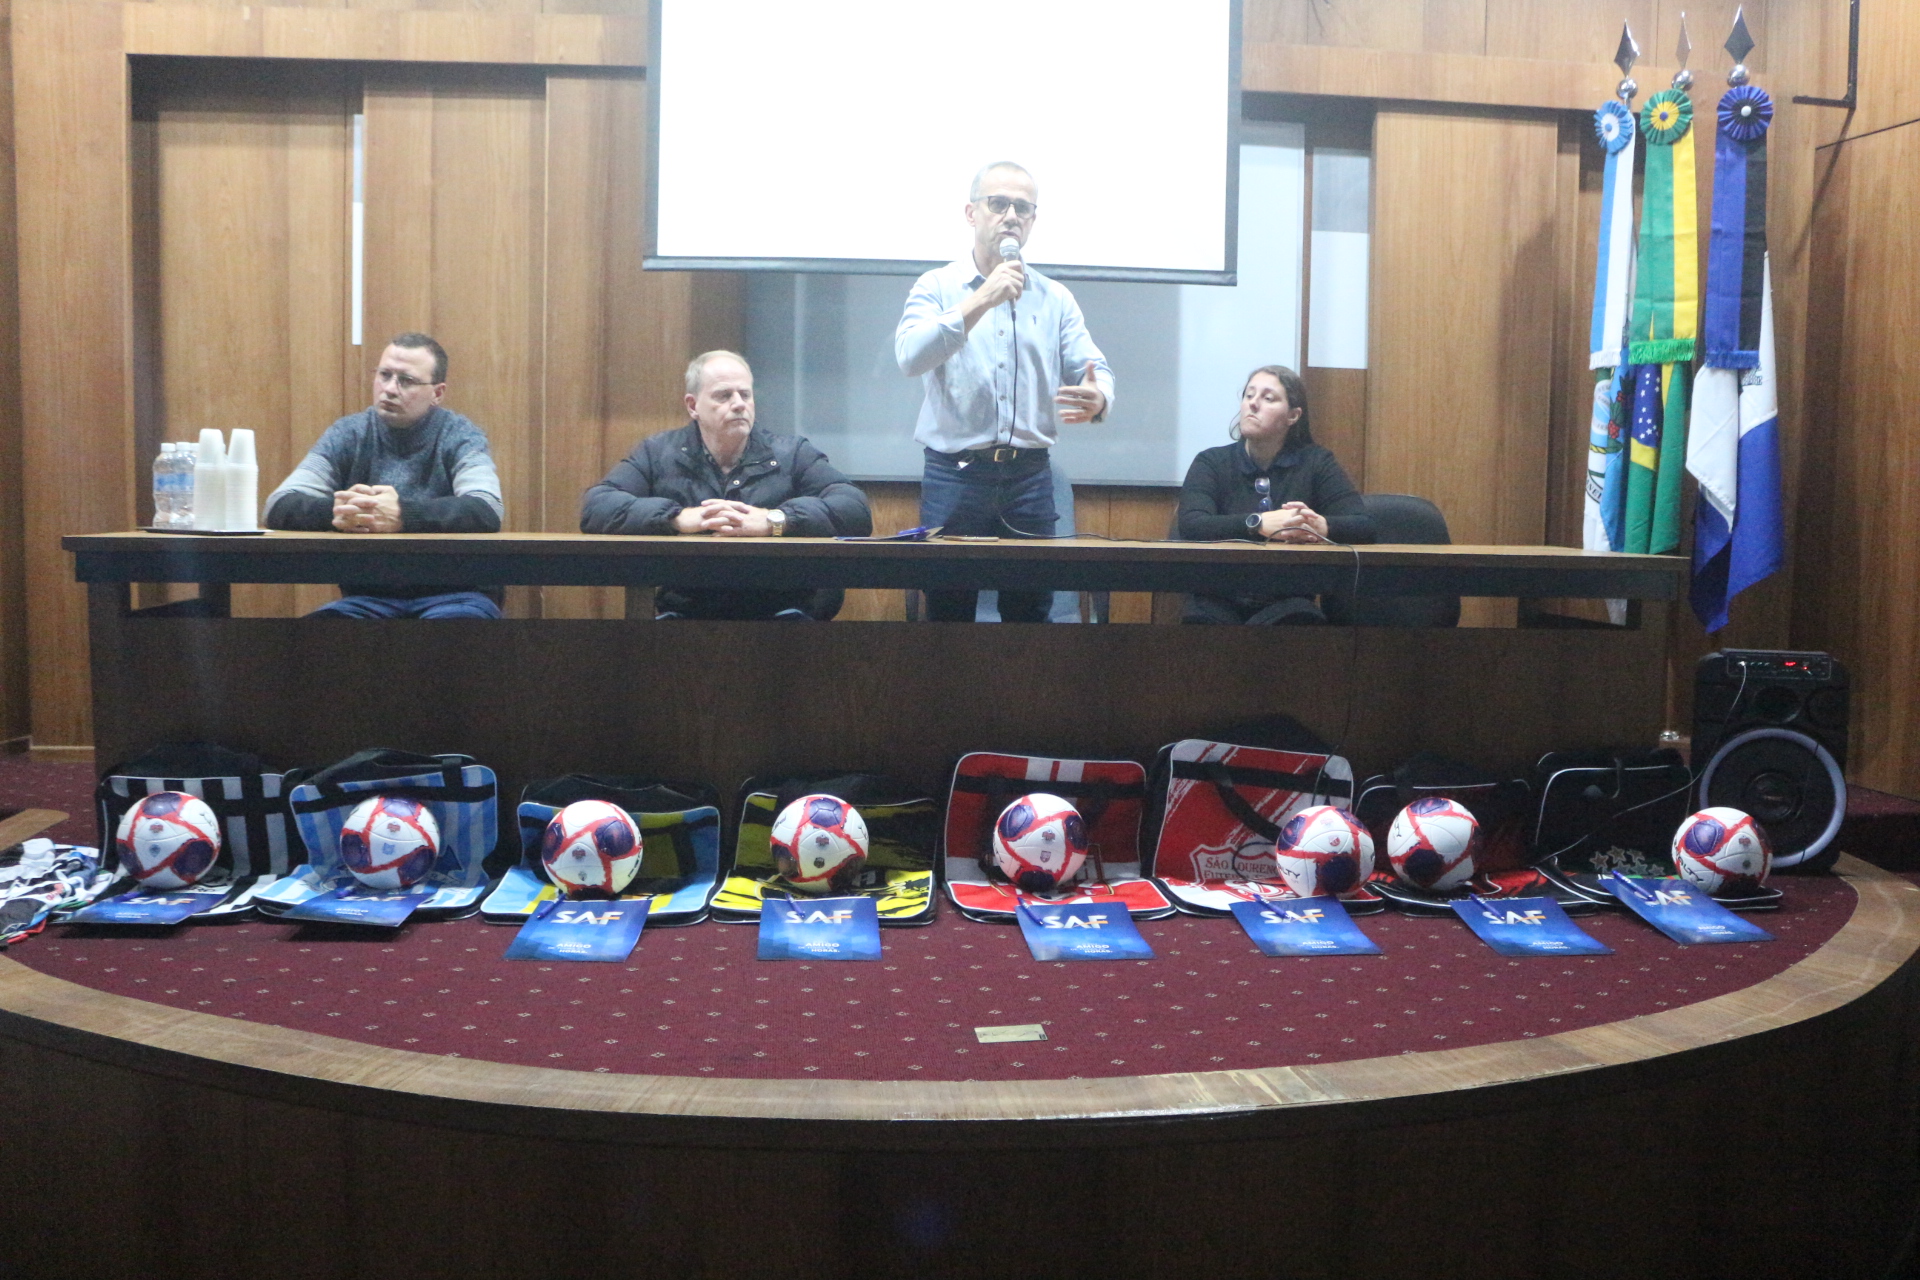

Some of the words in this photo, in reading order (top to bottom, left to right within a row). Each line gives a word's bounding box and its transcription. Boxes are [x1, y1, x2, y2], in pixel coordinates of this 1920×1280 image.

[1205, 856, 1229, 870] SÃO
[551, 911, 624, 925] SAF
[784, 910, 853, 924] SAF
[1042, 915, 1108, 929] SAF
[1260, 909, 1324, 924] SAF
